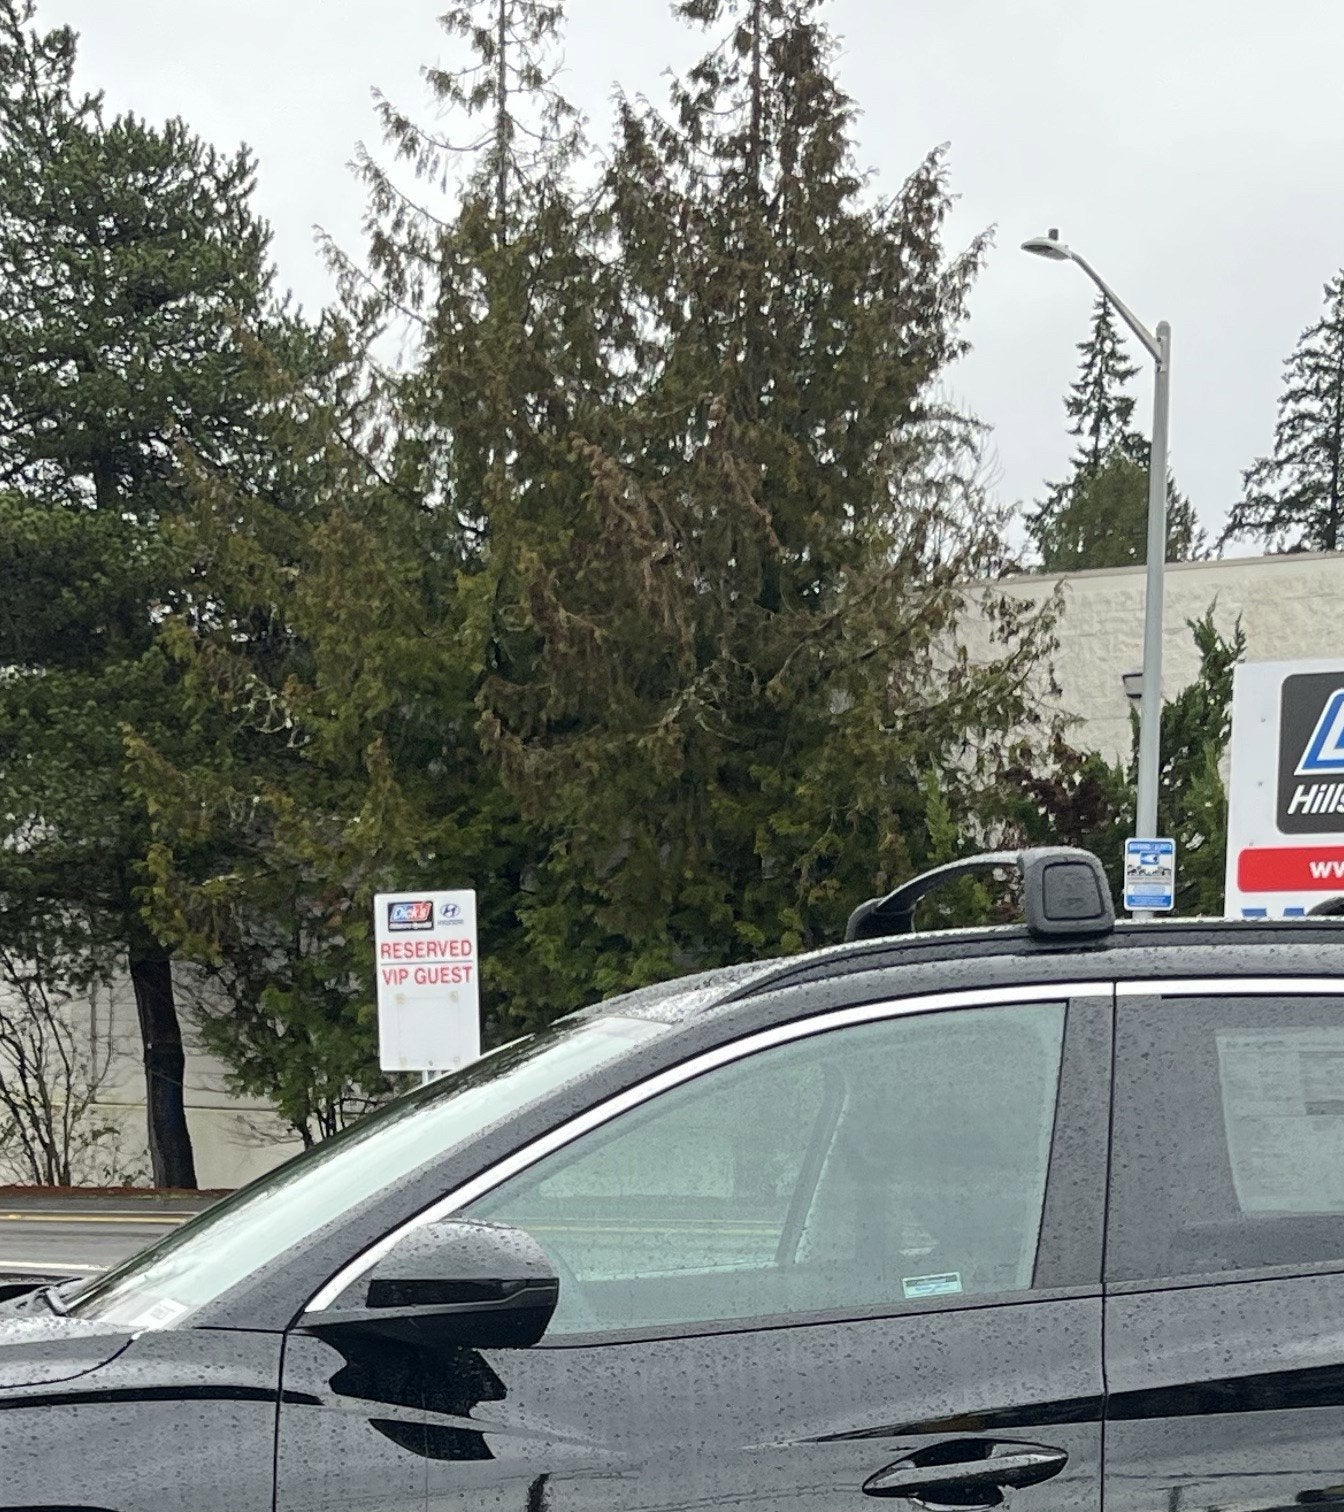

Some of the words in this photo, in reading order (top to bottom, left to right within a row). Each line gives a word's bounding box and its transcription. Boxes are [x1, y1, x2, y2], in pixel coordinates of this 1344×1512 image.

[380, 939, 472, 959] RESERVED
[382, 968, 408, 986] VIP
[414, 965, 472, 985] GUEST
